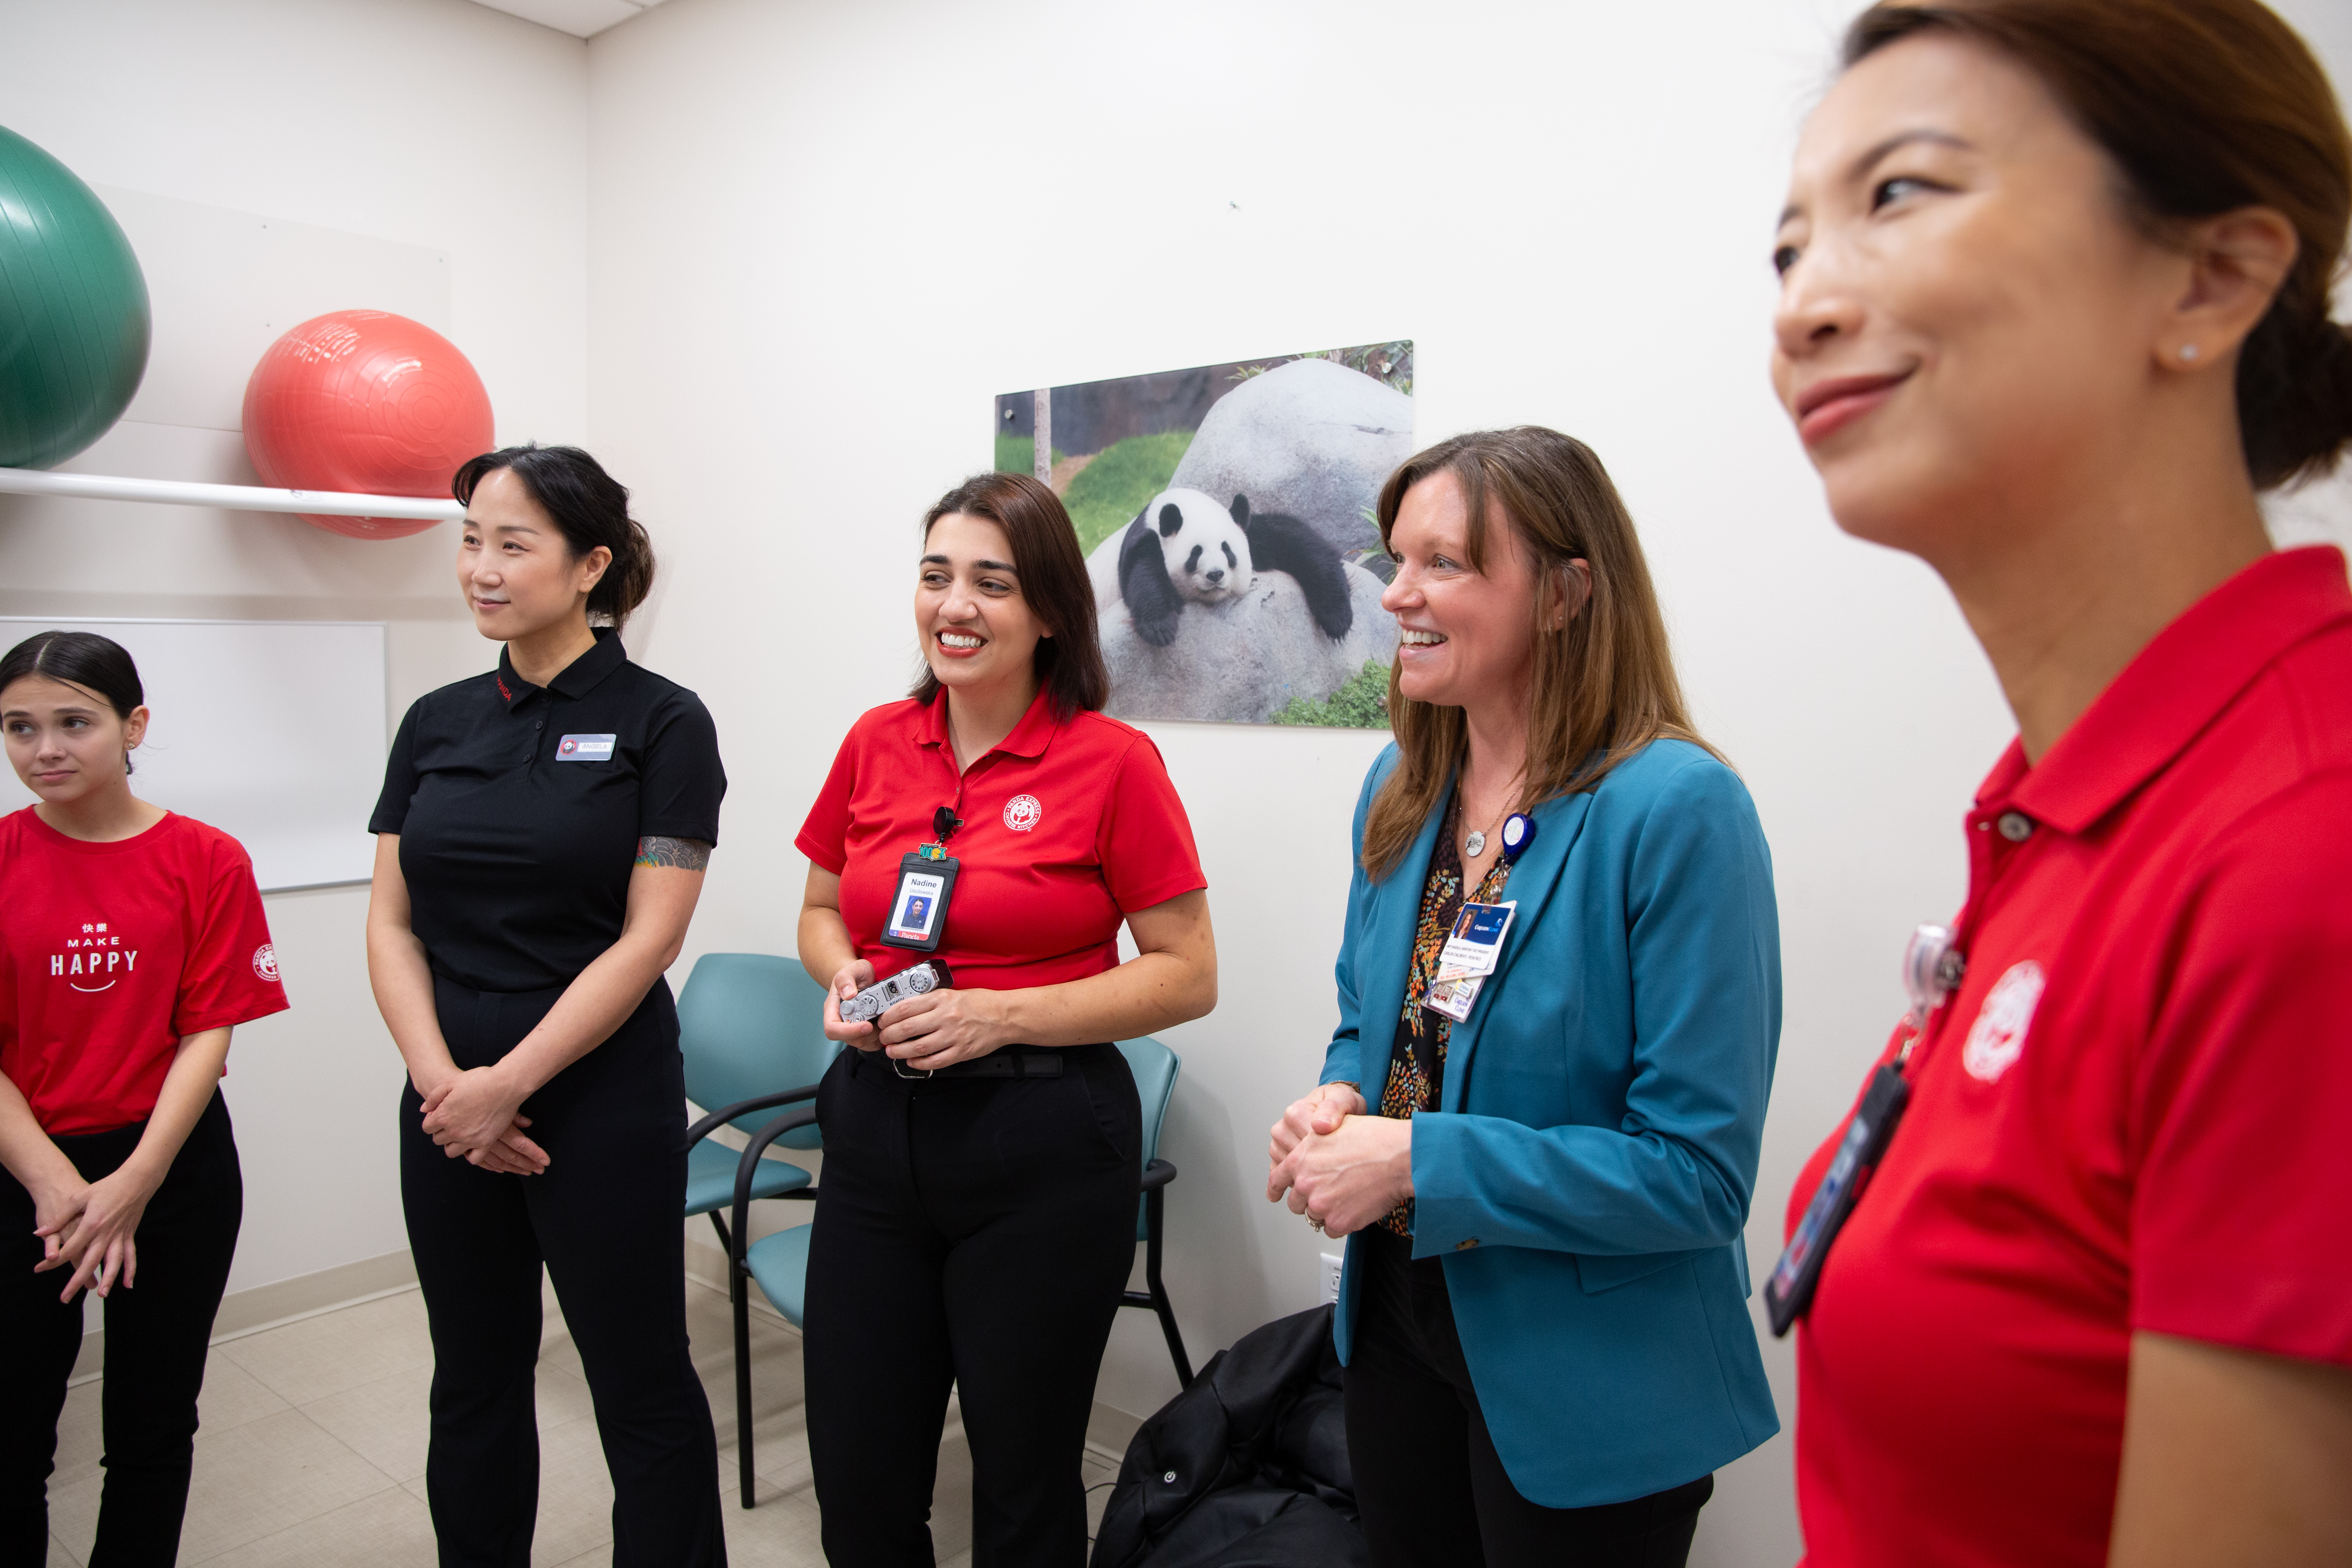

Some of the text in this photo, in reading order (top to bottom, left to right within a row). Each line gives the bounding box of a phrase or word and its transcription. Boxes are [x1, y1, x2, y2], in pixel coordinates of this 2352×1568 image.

[1007, 796, 1040, 814] PANDA EXPRESS
[1005, 812, 1037, 829] CHINESE KITCHEN
[911, 878, 937, 888] Nadine
[82, 923, 107, 933] 快樂
[67, 936, 120, 948] MAKE
[51, 950, 138, 976] HAPPY
[255, 949, 266, 965] PANDA
[259, 970, 277, 979] CHINESE
[889, 997, 905, 1006] FUJIFILM
